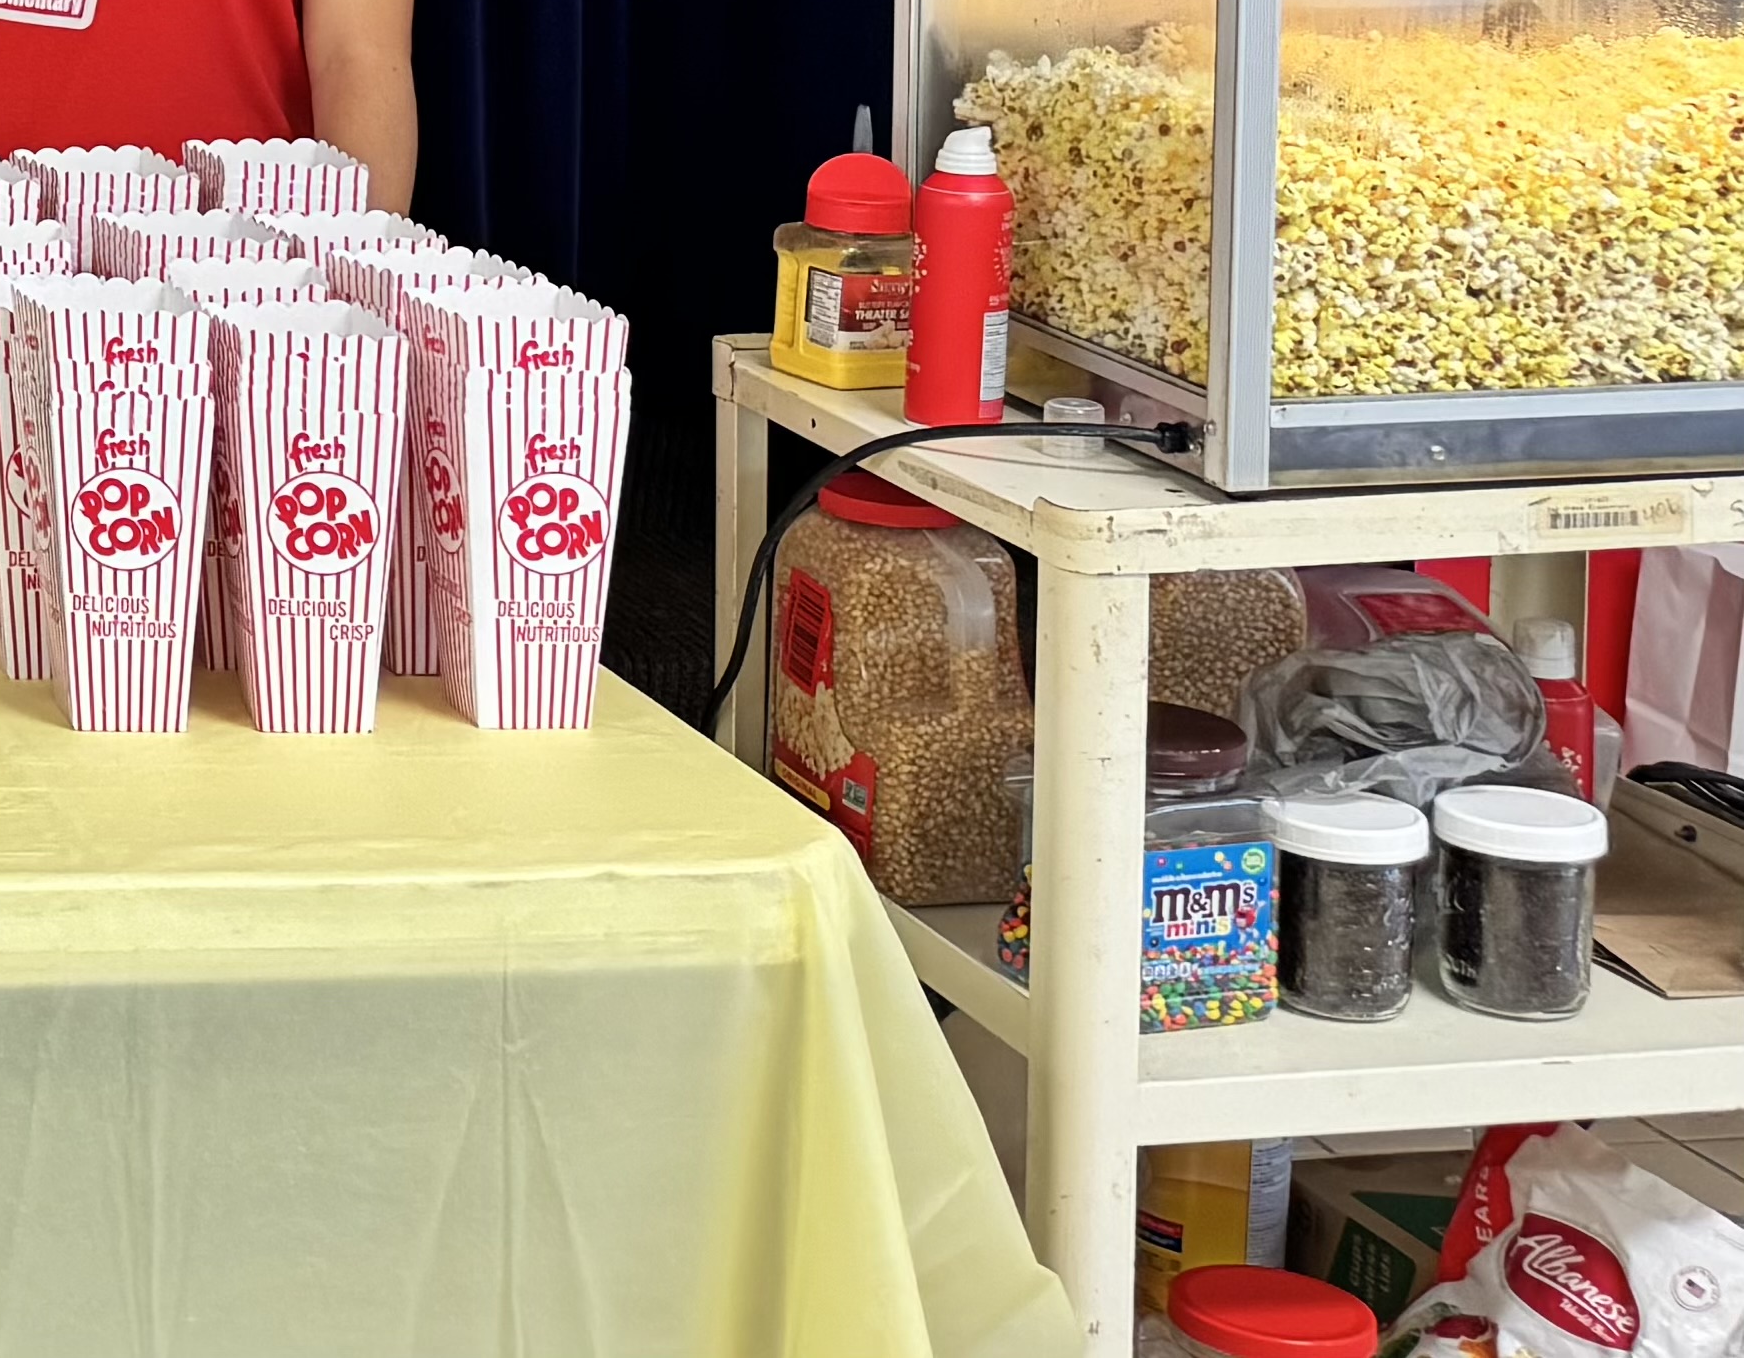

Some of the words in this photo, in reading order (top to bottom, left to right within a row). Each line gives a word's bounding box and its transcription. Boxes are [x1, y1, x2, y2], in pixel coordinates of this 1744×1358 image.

[855, 309, 897, 321] THEATER
[104, 336, 159, 368] fresh
[519, 340, 574, 374] fresh
[96, 428, 151, 469] fresh
[289, 432, 346, 473] fresh
[525, 433, 581, 474] fresh
[79, 477, 150, 526] POP
[274, 481, 347, 531] POP
[506, 482, 580, 531] POP
[89, 506, 177, 557] CORN
[286, 509, 374, 561] CORN
[516, 510, 604, 561] CORN
[72, 594, 150, 615] DELICIOUS
[268, 598, 347, 618] DELICIOUS
[497, 600, 576, 619] DELICIOUS
[92, 620, 177, 639] NUTRITIOUS
[329, 624, 374, 642] CRISP
[516, 624, 601, 643] NUTRITIOUS
[1166, 918, 1229, 938] minis
[1509, 1233, 1635, 1335] Albanese
